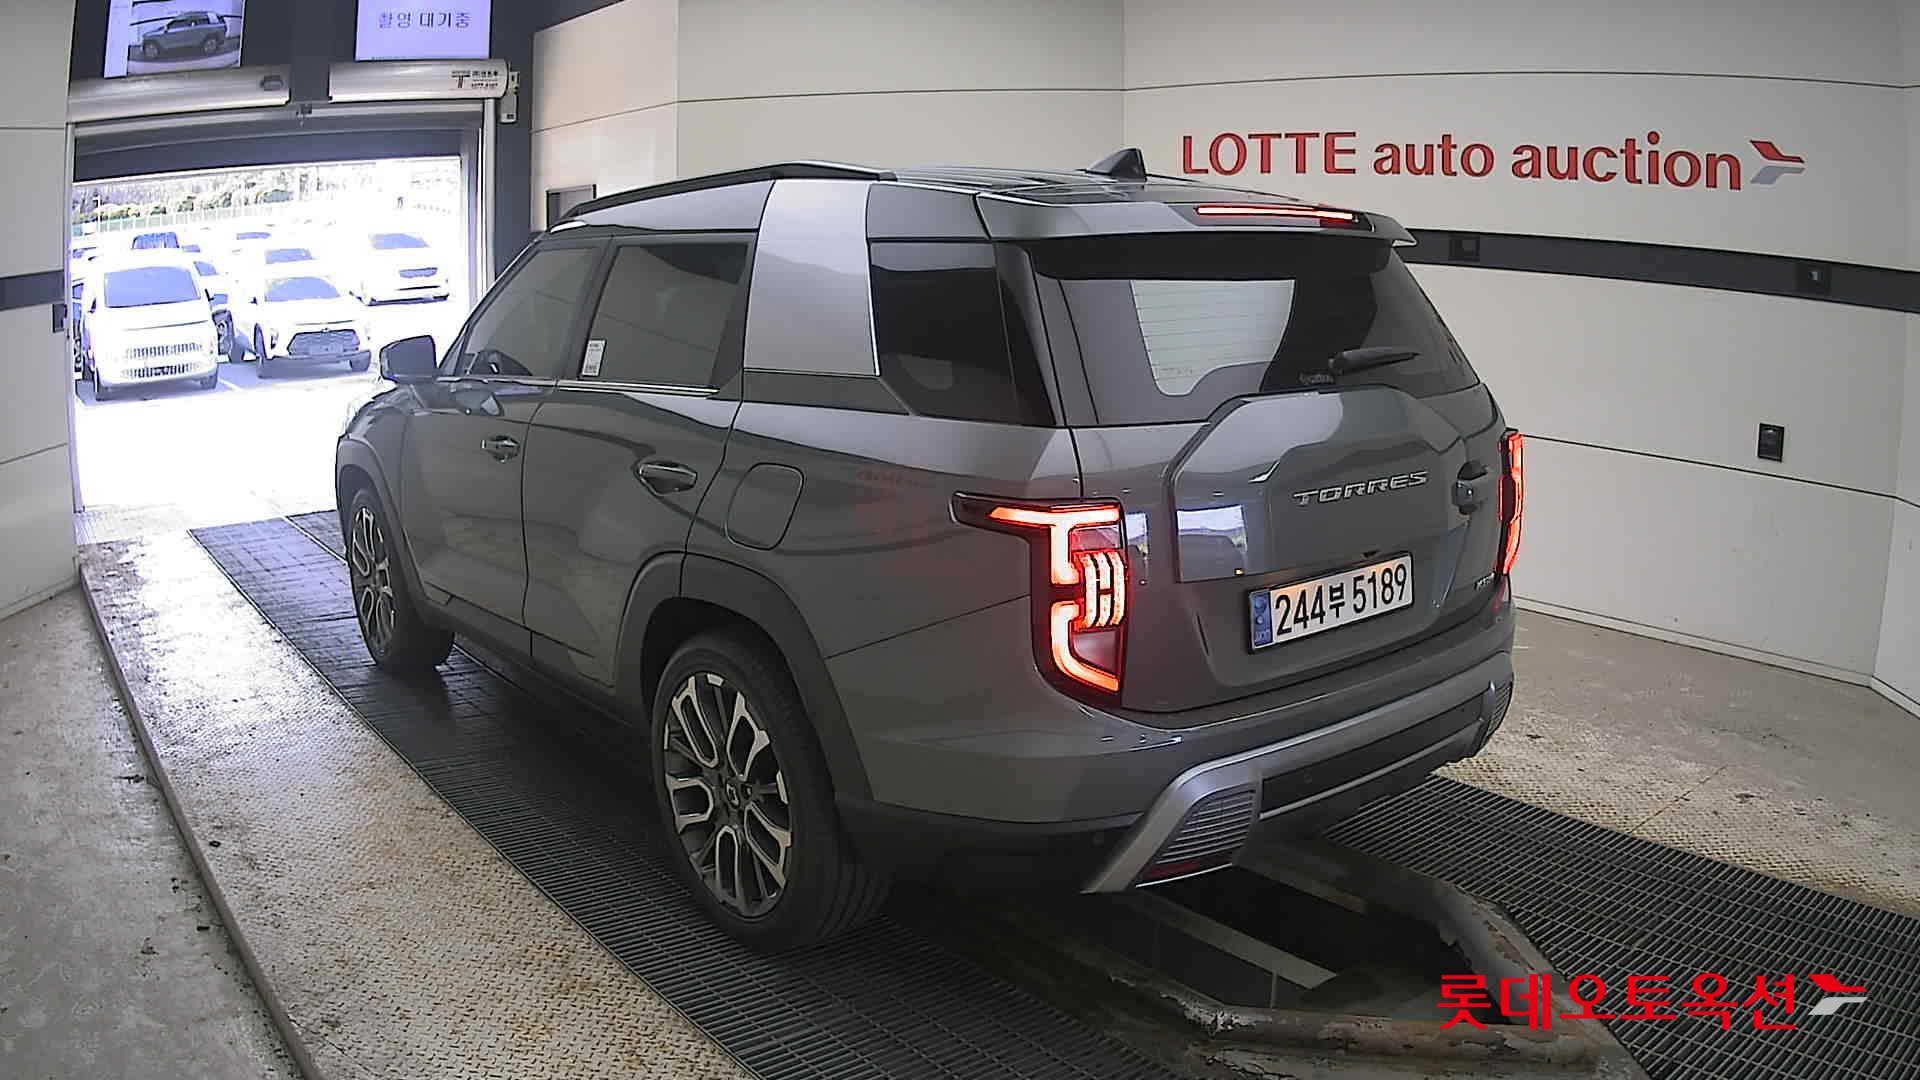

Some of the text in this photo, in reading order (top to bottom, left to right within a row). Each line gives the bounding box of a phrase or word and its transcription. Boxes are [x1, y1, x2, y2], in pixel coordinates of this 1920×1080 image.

[420, 11, 473, 29] 대기중
[1182, 131, 1742, 190] LOTTE auto auction
[1294, 470, 1429, 506] TORRES
[1275, 564, 1408, 636] 244부 5189
